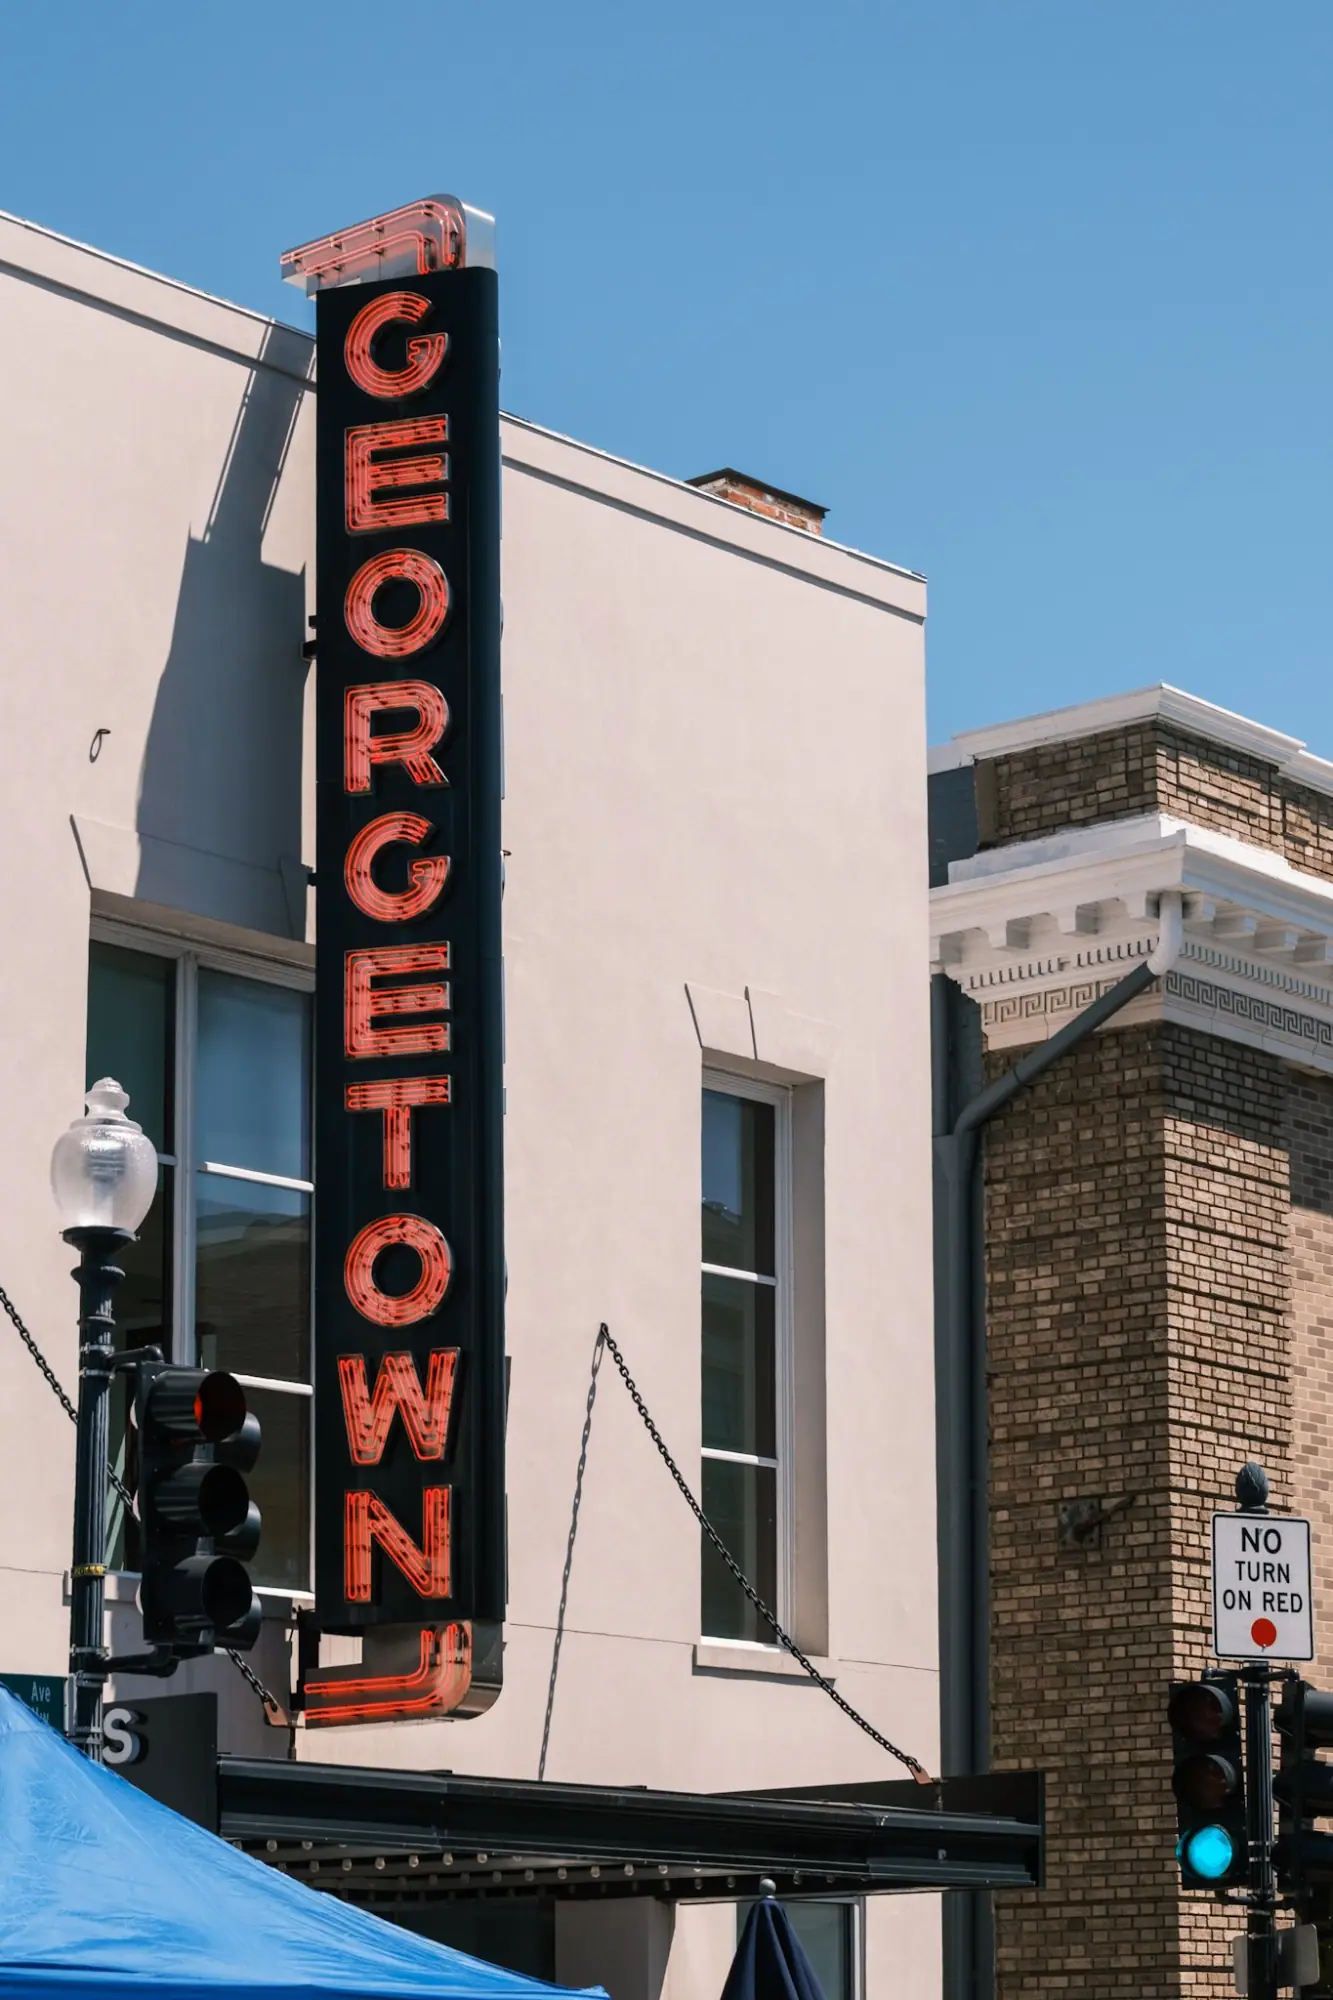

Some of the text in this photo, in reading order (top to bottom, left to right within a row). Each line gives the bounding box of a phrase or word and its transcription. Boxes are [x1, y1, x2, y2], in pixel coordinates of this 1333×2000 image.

[338, 291, 461, 1603] GEORGETOWN
[1242, 1527, 1282, 1555] NO
[1235, 1560, 1291, 1584] TURN
[1222, 1589, 1303, 1614] ON RED
[31, 1681, 51, 1702] Ave
